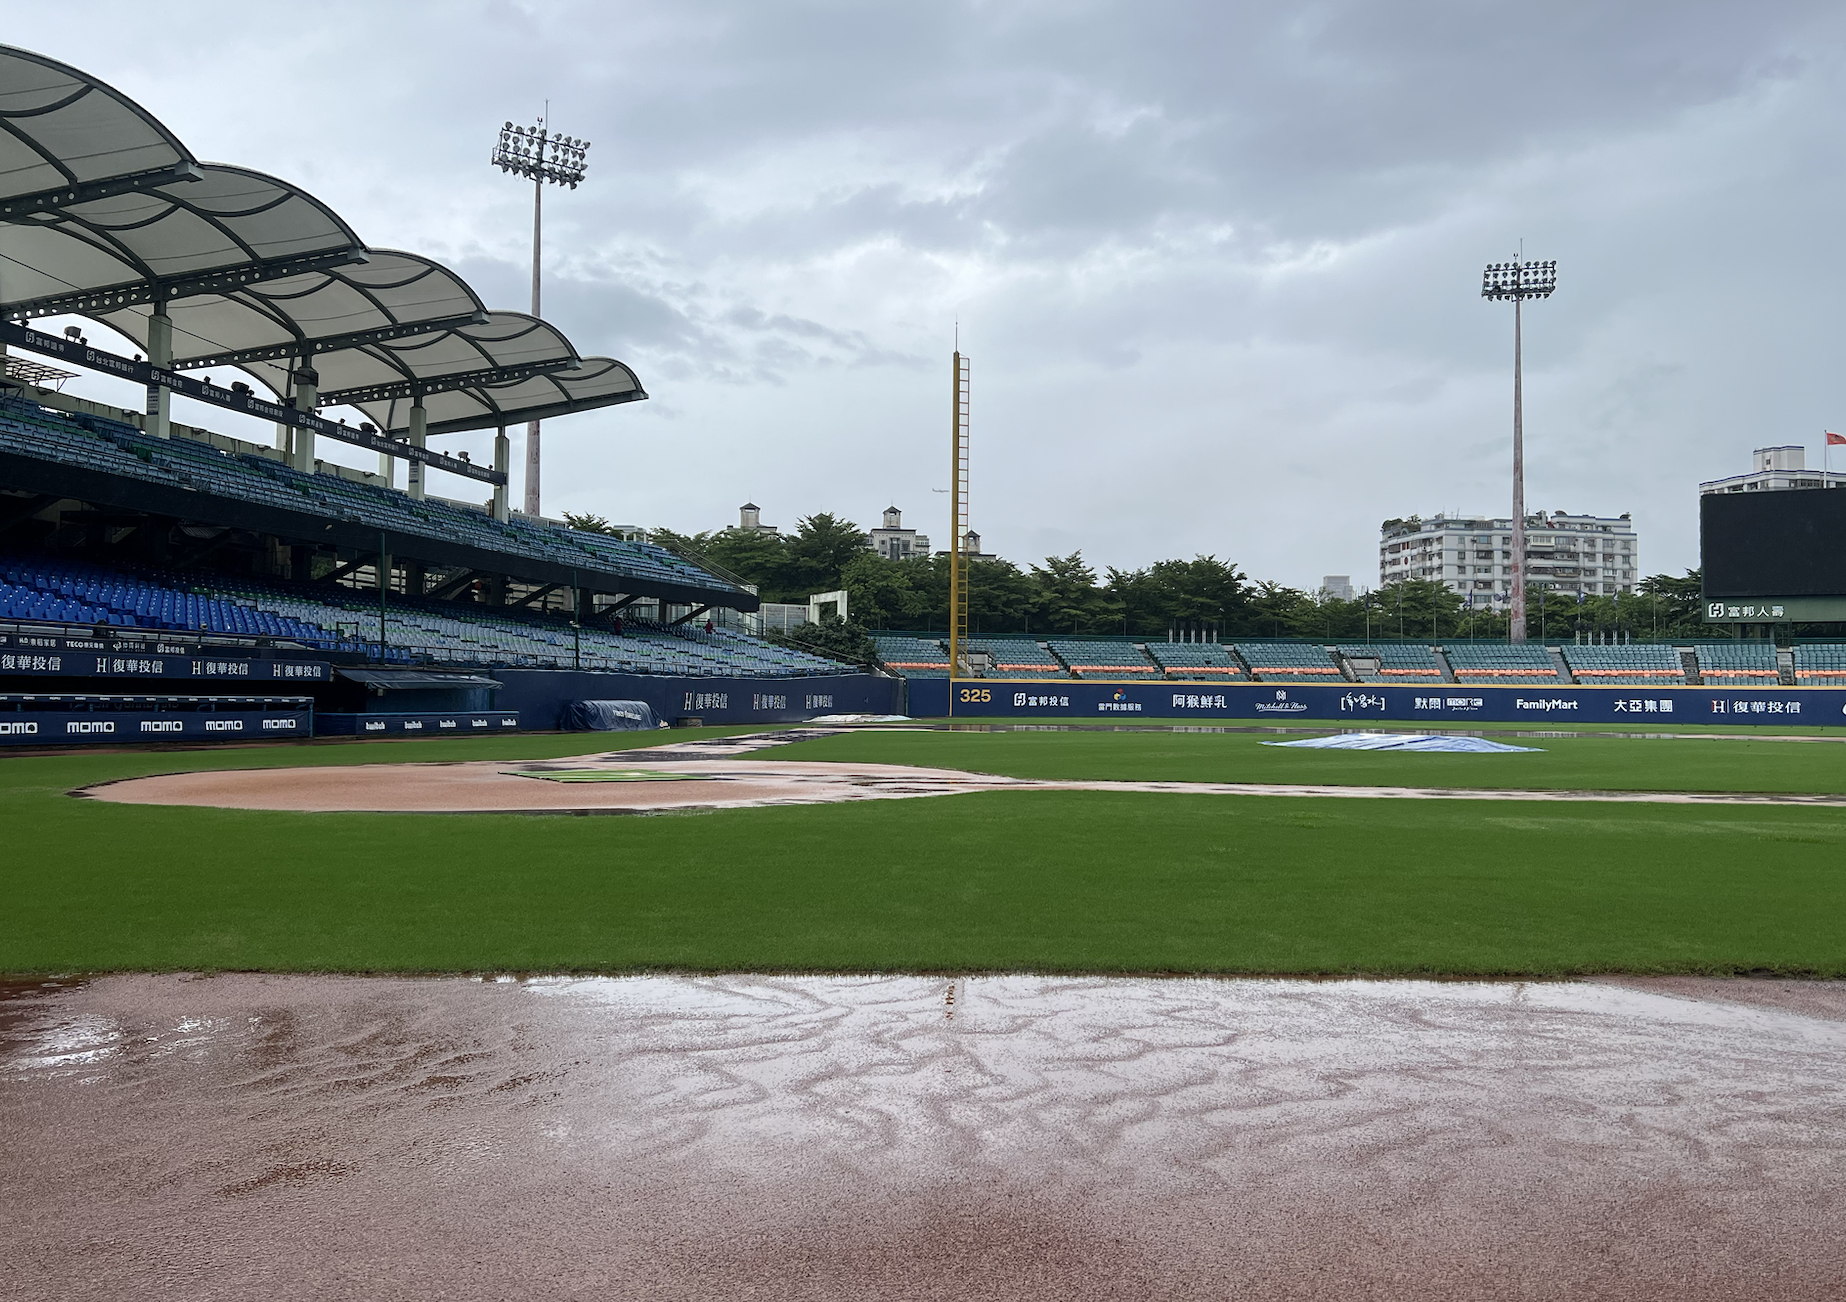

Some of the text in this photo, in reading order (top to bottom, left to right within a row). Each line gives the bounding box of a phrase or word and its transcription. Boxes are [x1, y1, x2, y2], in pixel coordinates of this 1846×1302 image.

[1728, 606, 1784, 617] 富邦人壽
[1, 654, 62, 671] 復華投信
[113, 659, 163, 674] 復華投信
[206, 662, 249, 675] 復華投信
[285, 665, 321, 678] 復華投信
[695, 693, 728, 710] 復華投信
[762, 695, 786, 709] 復華投信
[813, 695, 833, 708] 復華投信
[960, 689, 992, 703] 325
[1028, 696, 1069, 707] 富邦投信
[1173, 695, 1228, 709] 阿猴鮮乳
[1516, 699, 1579, 711] FamilyMart
[1614, 700, 1673, 712] 大亞集團
[1733, 701, 1802, 714] 復華投信
[67, 722, 115, 734] momo
[141, 721, 183, 732] momo
[206, 720, 243, 731] momo
[263, 719, 296, 729] momo
